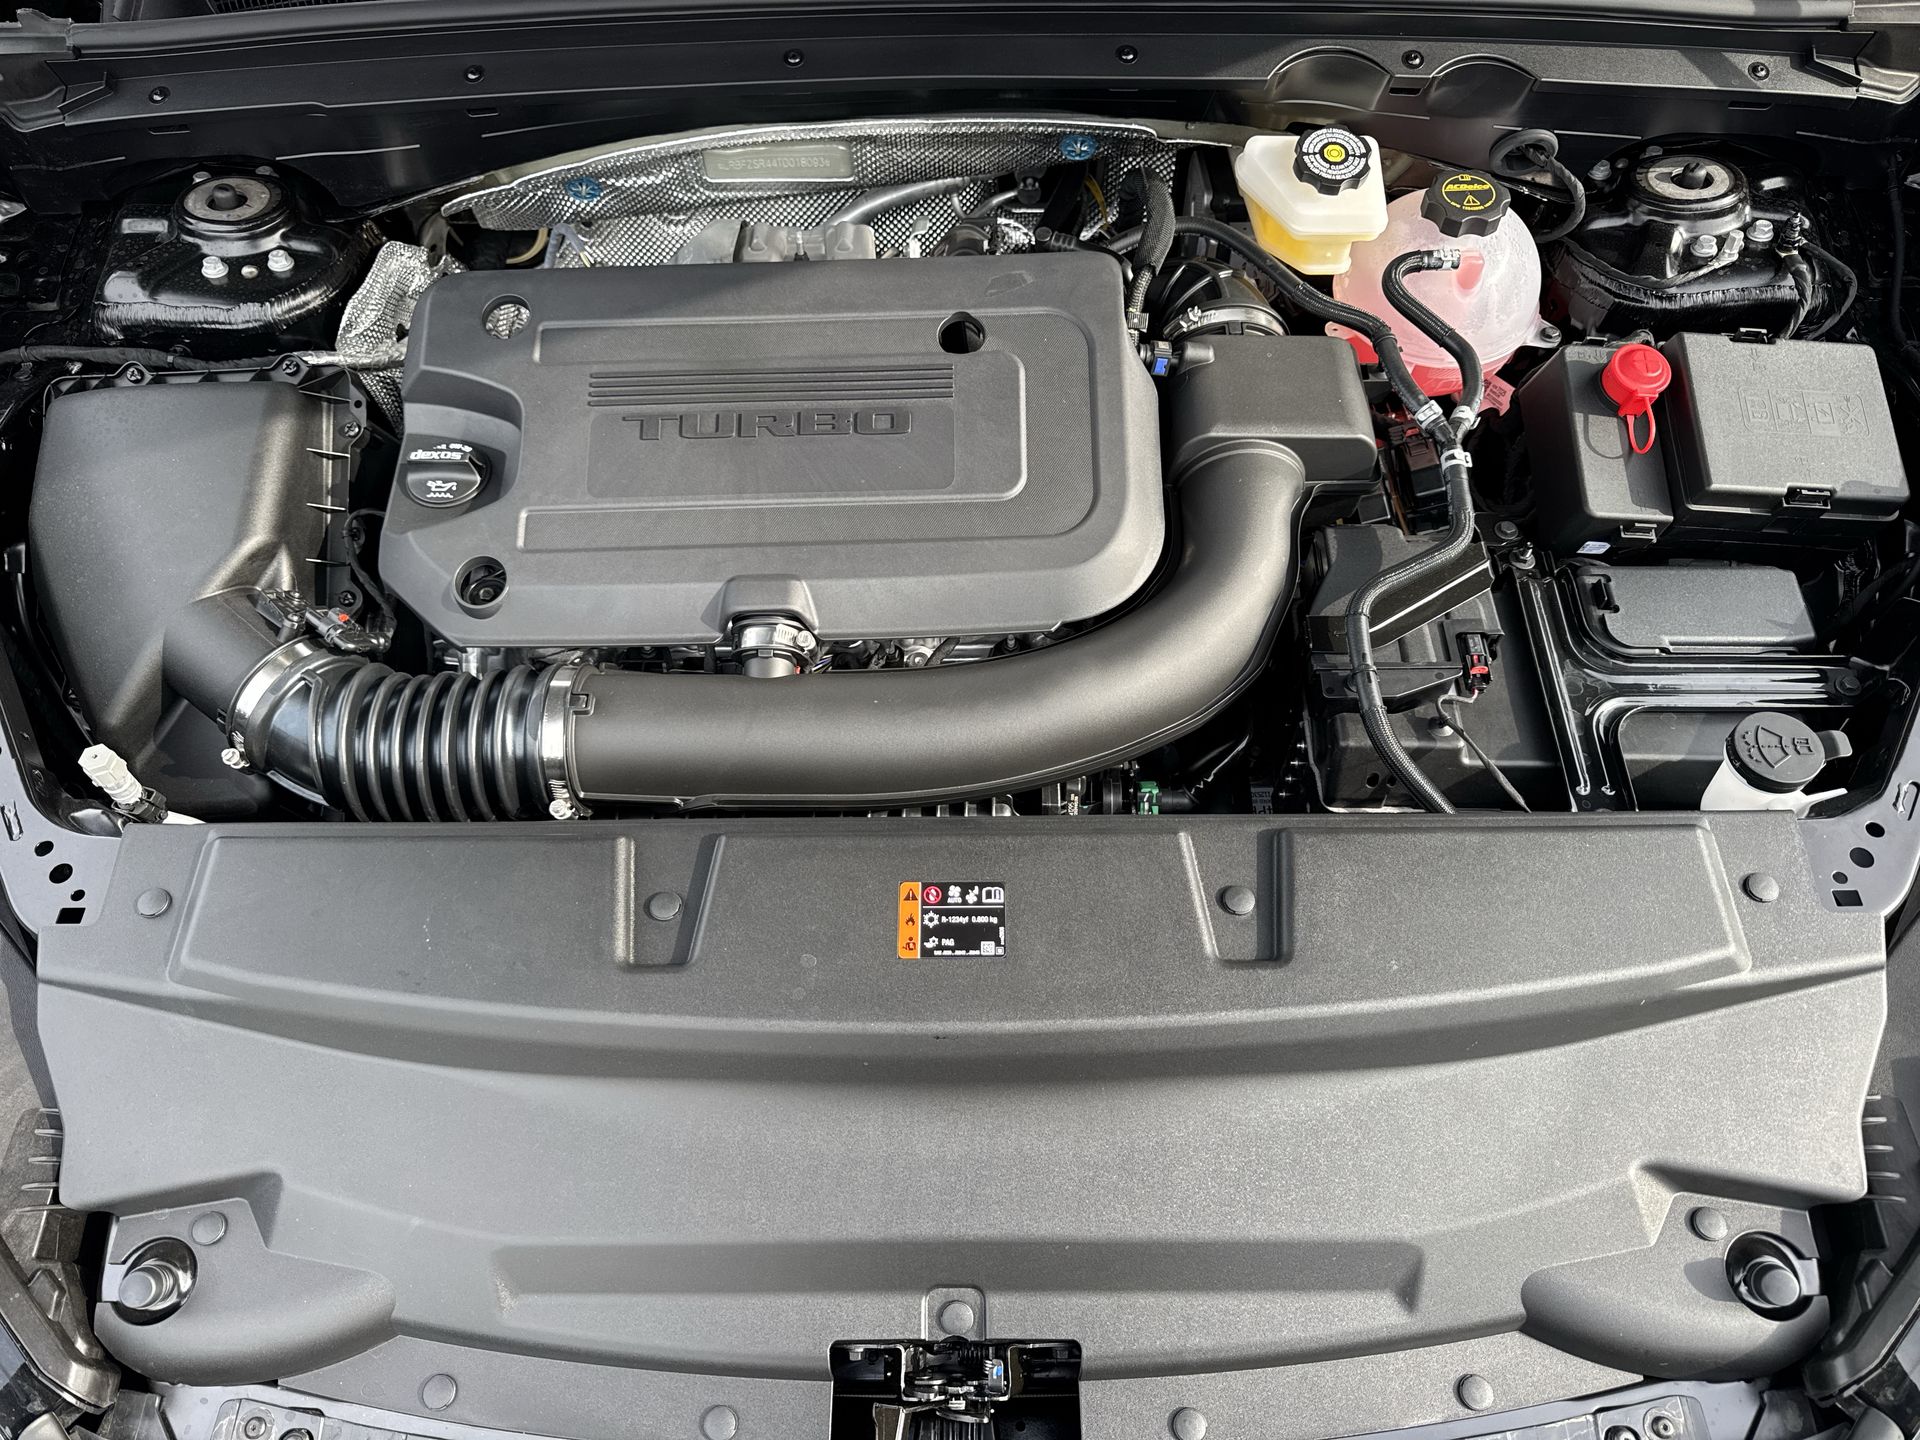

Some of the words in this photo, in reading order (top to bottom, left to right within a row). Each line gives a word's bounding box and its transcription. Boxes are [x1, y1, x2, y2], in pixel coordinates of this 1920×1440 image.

[621, 407, 912, 441] TURBO
[410, 449, 464, 460] dexos
[941, 916, 968, 924] R-1234yf
[990, 916, 998, 924] kg
